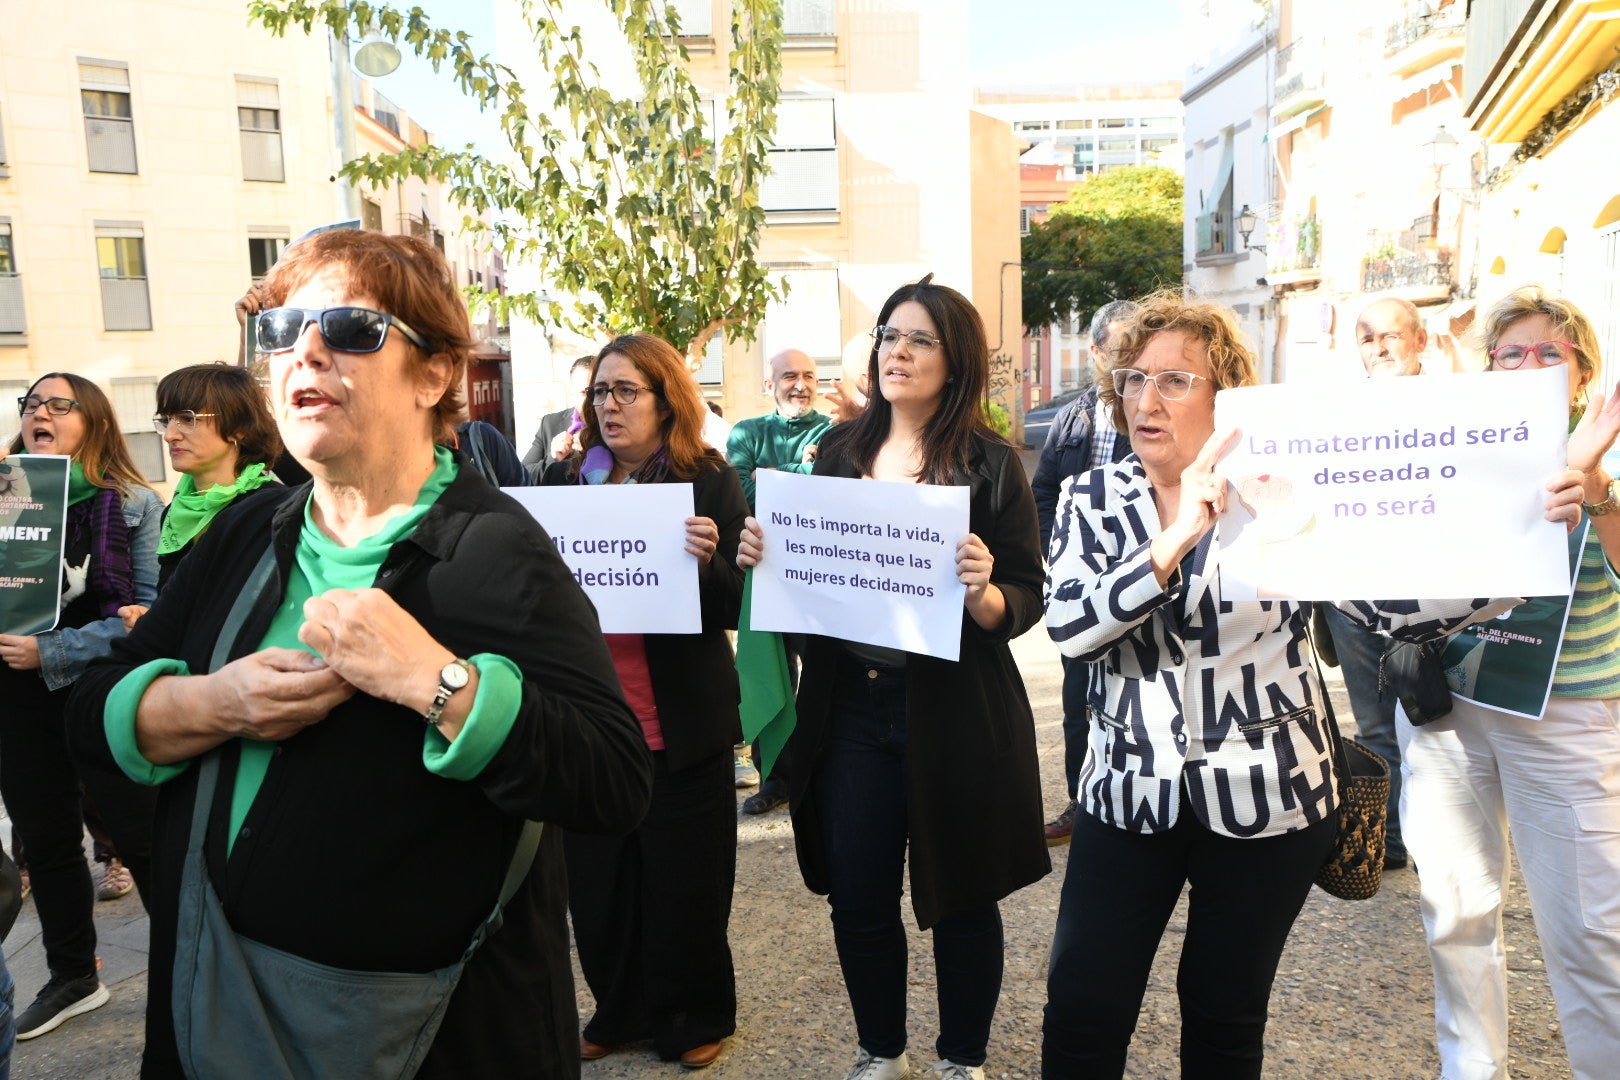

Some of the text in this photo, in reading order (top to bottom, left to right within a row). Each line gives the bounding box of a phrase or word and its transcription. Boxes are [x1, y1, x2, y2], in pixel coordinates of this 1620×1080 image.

[1249, 420, 1529, 455] La maternidad será
[1313, 463, 1457, 485] deseada o
[1334, 493, 1436, 518] no será
[0, 526, 51, 541] MENT
[771, 511, 945, 545] No les importa la vida,
[551, 536, 646, 558] i cuerpo
[785, 539, 931, 569] les molesta que las
[573, 568, 658, 586] decisión
[785, 567, 934, 597] mujeres decidamos
[1476, 633, 1509, 644] ALICANTE
[1503, 632, 1536, 644] CARMEN
